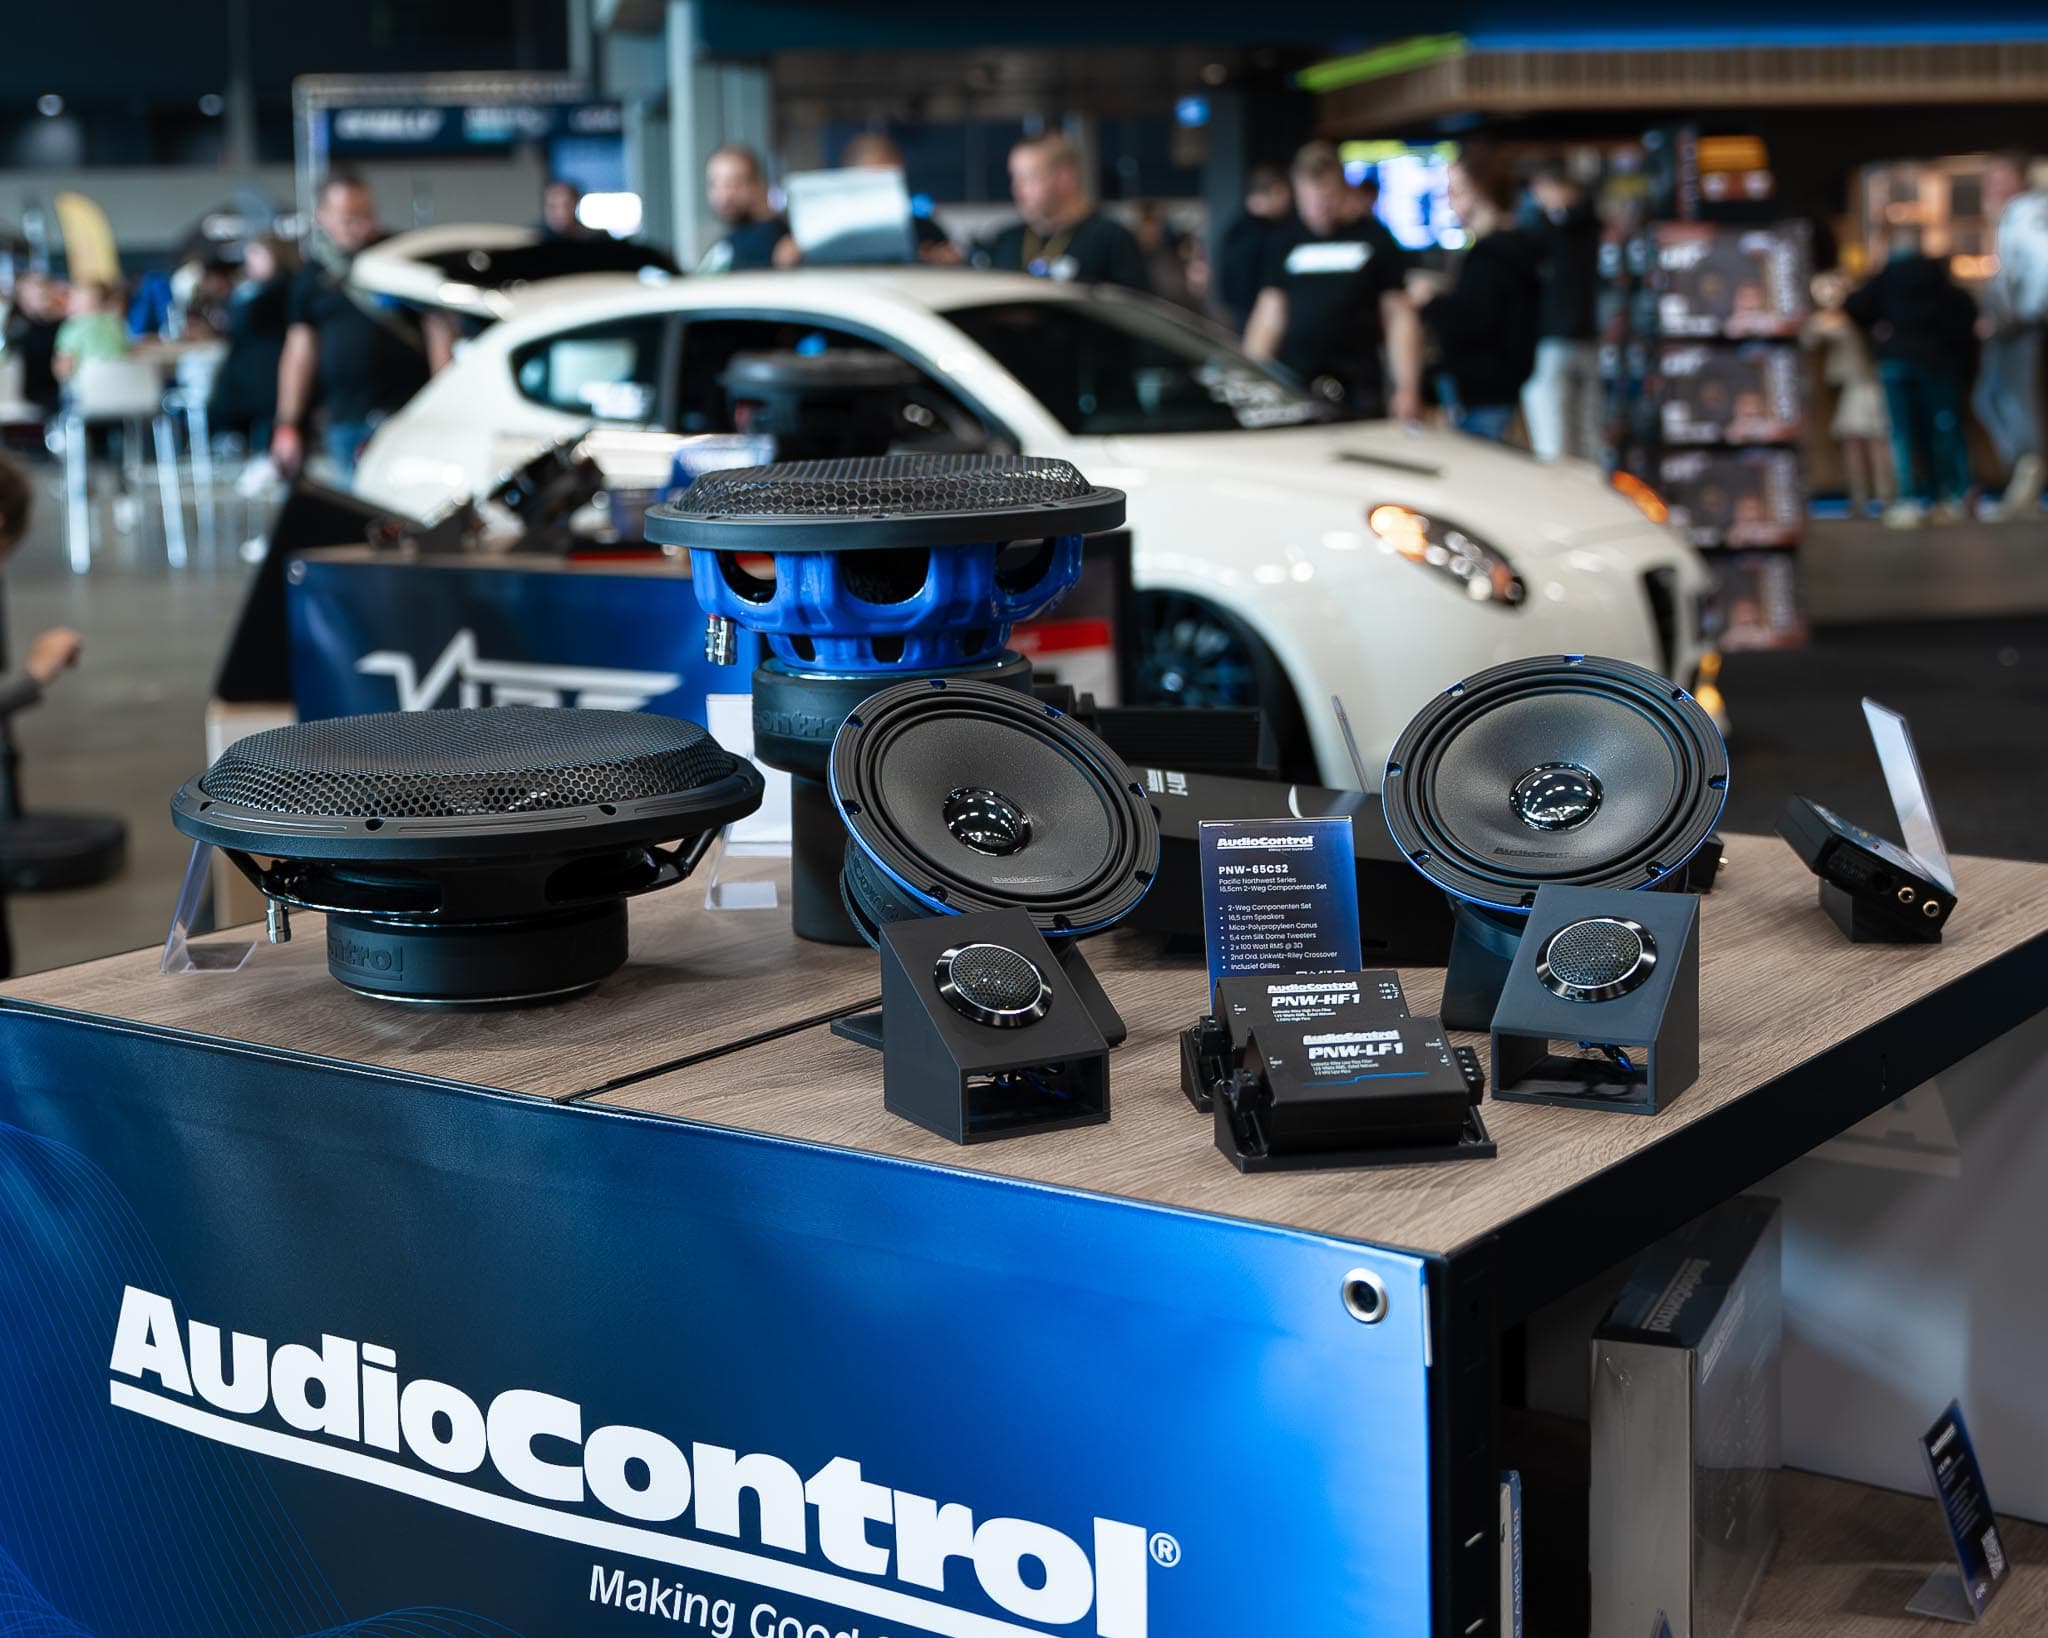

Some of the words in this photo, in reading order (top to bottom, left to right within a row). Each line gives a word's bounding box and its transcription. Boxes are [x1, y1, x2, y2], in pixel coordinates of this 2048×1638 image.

[1217, 836, 1314, 847] AudioControl
[1219, 865, 1289, 875] PNW-65CS2
[1243, 885, 1267, 893] 2-Weg
[1267, 884, 1315, 892] Componenten
[1228, 904, 1251, 912] 2-Weg
[1252, 903, 1300, 911] Componenten
[1300, 902, 1312, 910] Set
[1254, 913, 1285, 921] Speakers
[1260, 952, 1303, 960] Linkwitz-Riley
[1271, 993, 1361, 1007] PNW-HF1
[1308, 1042, 1404, 1060] PNW-LF1
[589, 1564, 737, 1638] Making
[750, 1603, 862, 1638] Go
